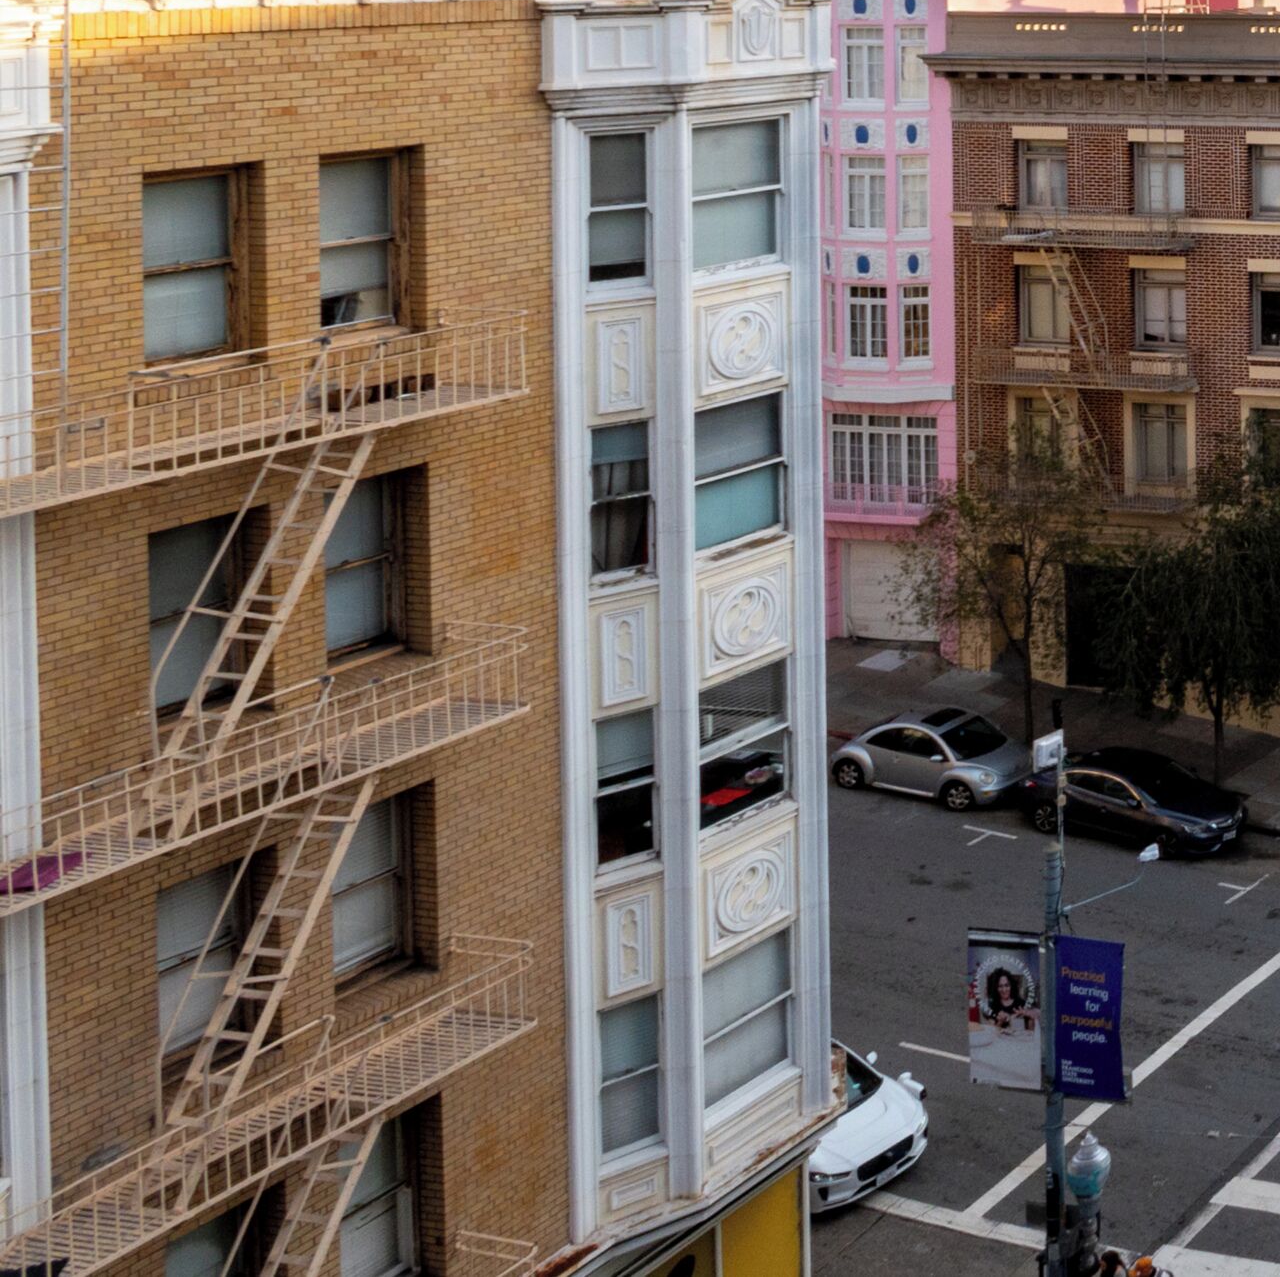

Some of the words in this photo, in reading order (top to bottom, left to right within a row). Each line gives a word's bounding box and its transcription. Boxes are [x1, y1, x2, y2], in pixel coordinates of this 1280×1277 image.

[1061, 966, 1106, 984] Practical
[1069, 982, 1109, 1003] learning
[1085, 1000, 1101, 1013] for
[1061, 1014, 1113, 1031] purposeful
[1072, 1030, 1108, 1044] people.
